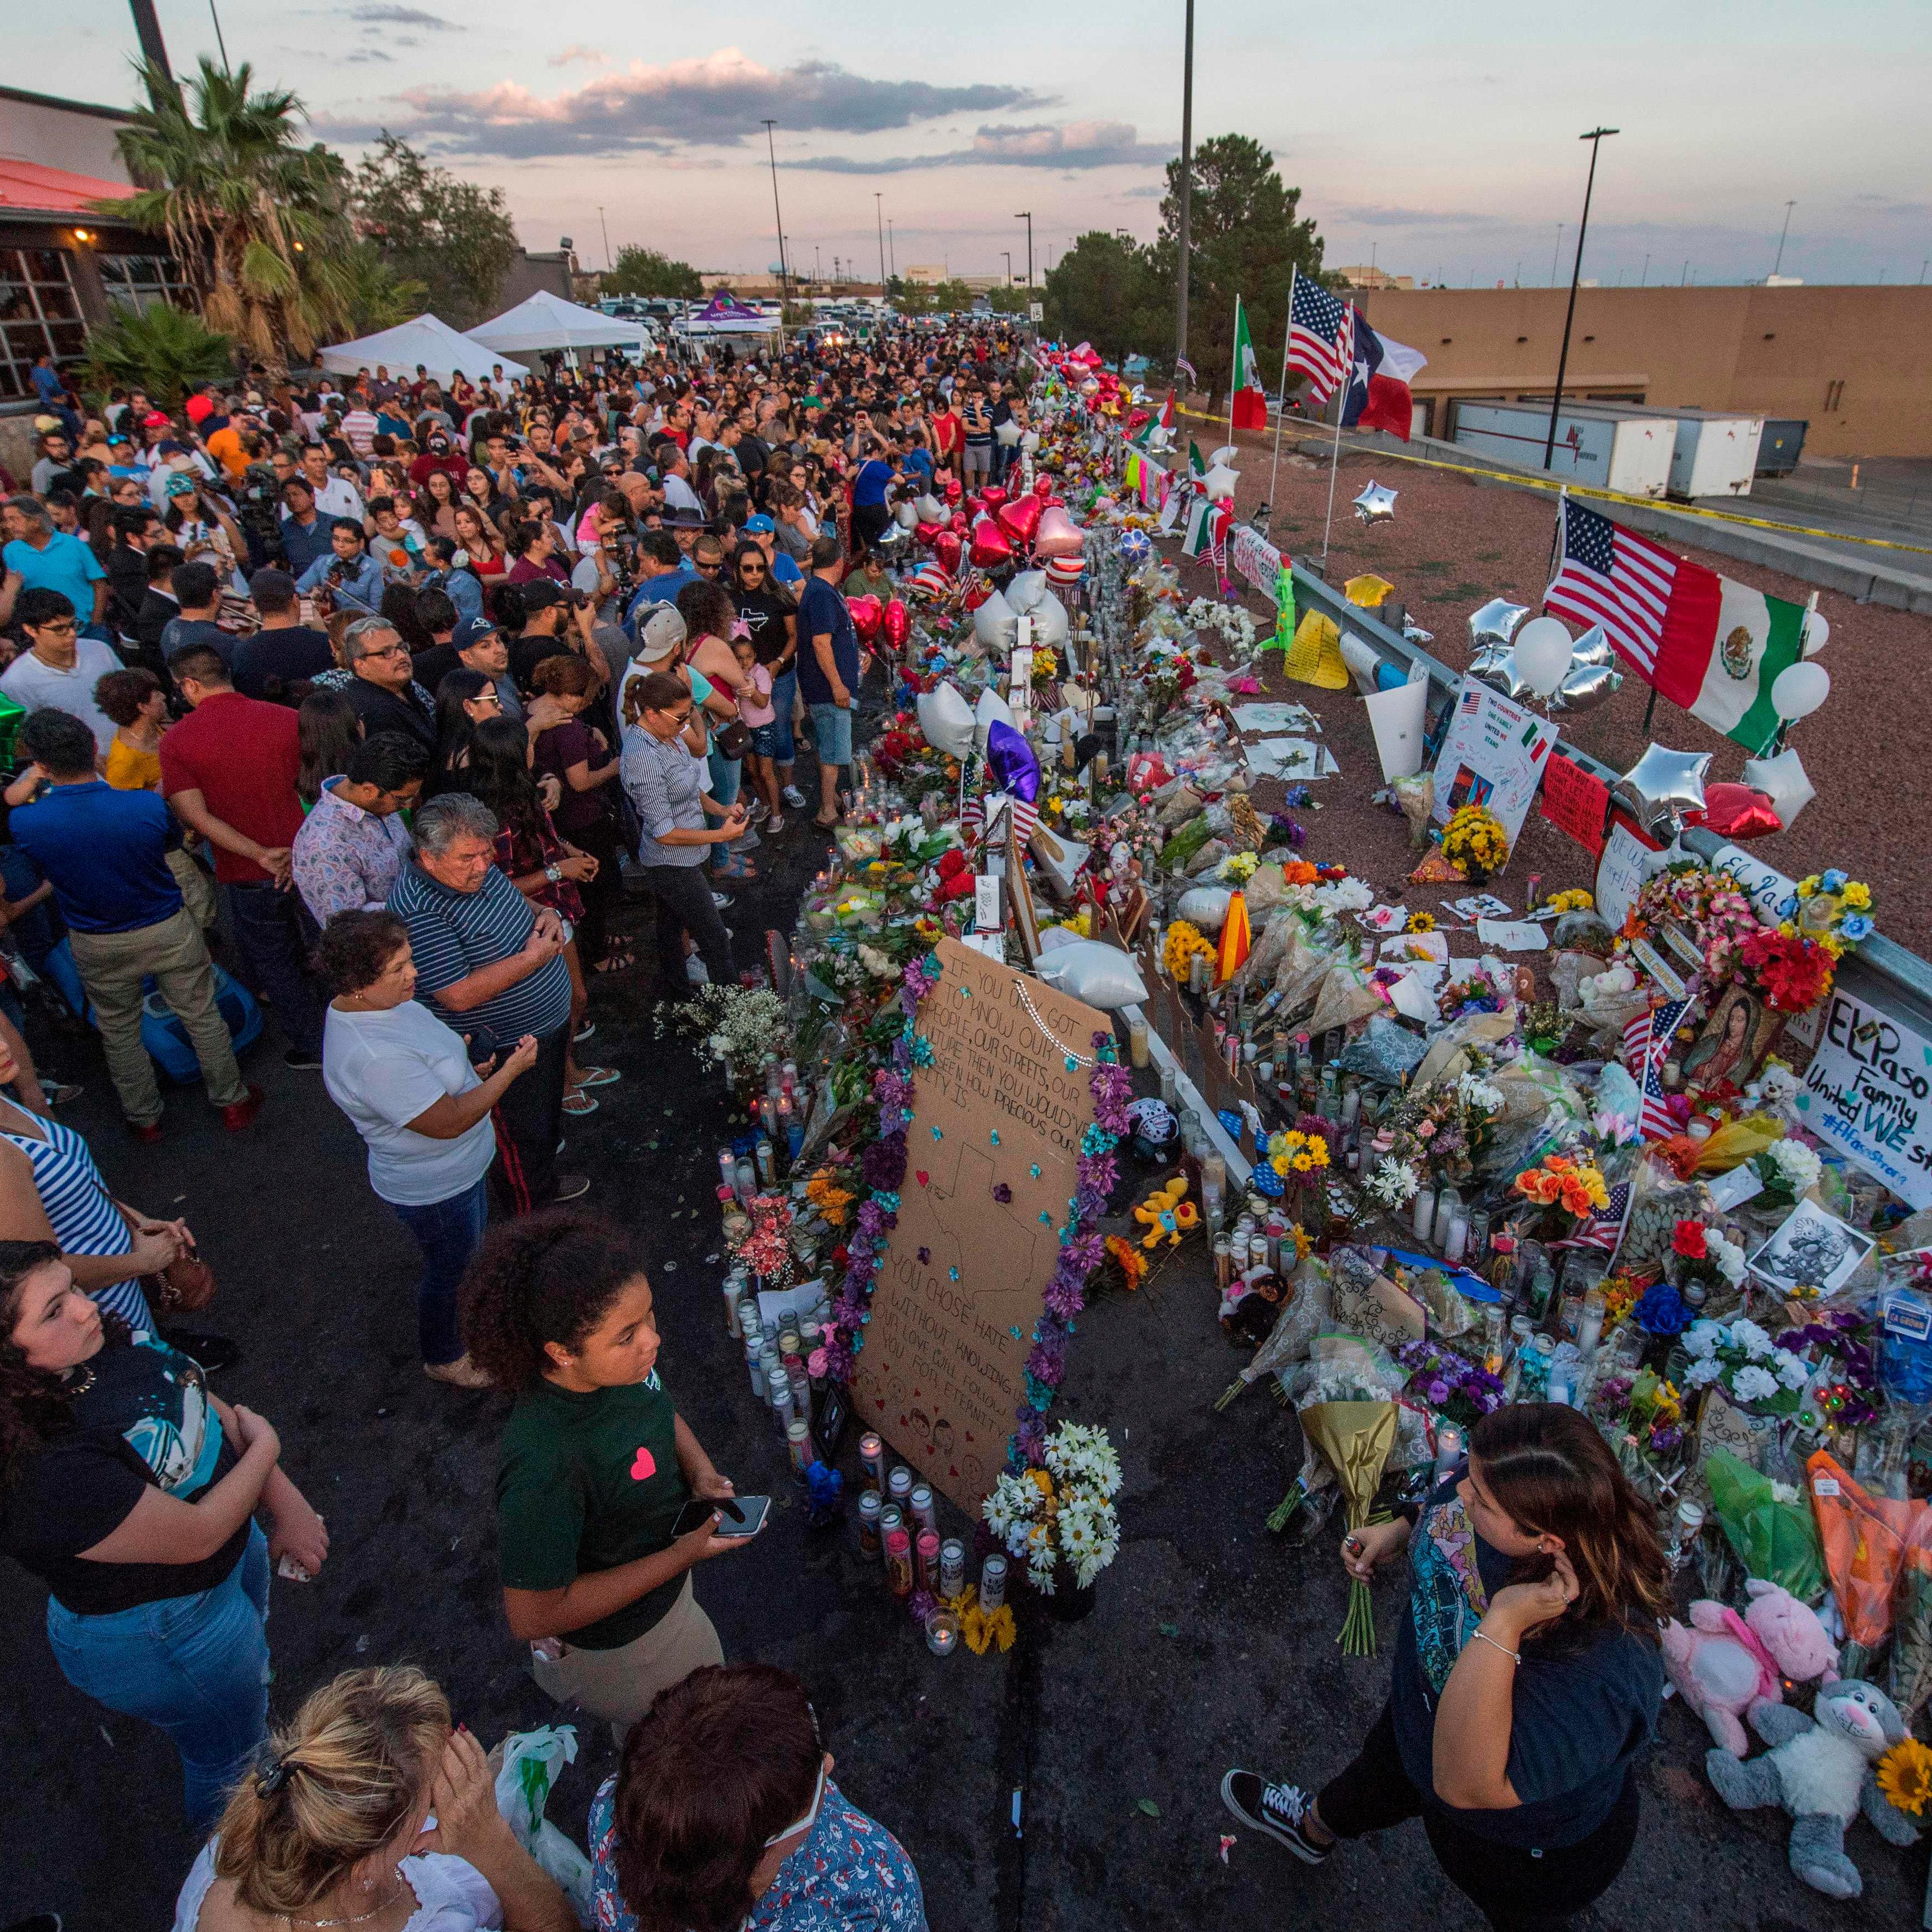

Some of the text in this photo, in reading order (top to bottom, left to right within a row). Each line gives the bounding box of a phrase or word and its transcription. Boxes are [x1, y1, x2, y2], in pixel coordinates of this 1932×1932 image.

[1032, 310, 1041, 319] 15
[1485, 722, 1508, 741] UNITED WE
[1488, 697, 1521, 722] TWO COUNTRIES
[1488, 710, 1512, 730] ONE FAMILY
[1484, 736, 1499, 749] STAND
[1611, 829, 1629, 855] WE
[1722, 857, 1789, 916] El Pas
[945, 981, 1054, 1062] TO KNOW OUR
[947, 955, 970, 979] IF
[979, 970, 1003, 999] YOU
[1048, 1008, 1081, 1036] GOT
[918, 1065, 952, 1095] CITY
[926, 998, 1080, 1106] PEOPLE, OUR STREETS, OUR
[967, 1047, 995, 1079] THEN
[999, 1067, 1023, 1097] YOU
[938, 1053, 1075, 1156] SEEN HOW PRECIOUS OUR
[1807, 1063, 1863, 1124] United
[1864, 1105, 1915, 1154] WE
[1852, 1066, 1918, 1128] Family
[874, 1301, 899, 1332] OUR
[902, 1324, 930, 1352] LOVE
[891, 1248, 1009, 1356] YOU CHOSE HATE
[891, 1287, 950, 1345] WITHOUT
[955, 1338, 1012, 1395] KNOWING
[883, 1327, 1006, 1437] YOU FOR ETERNITY
